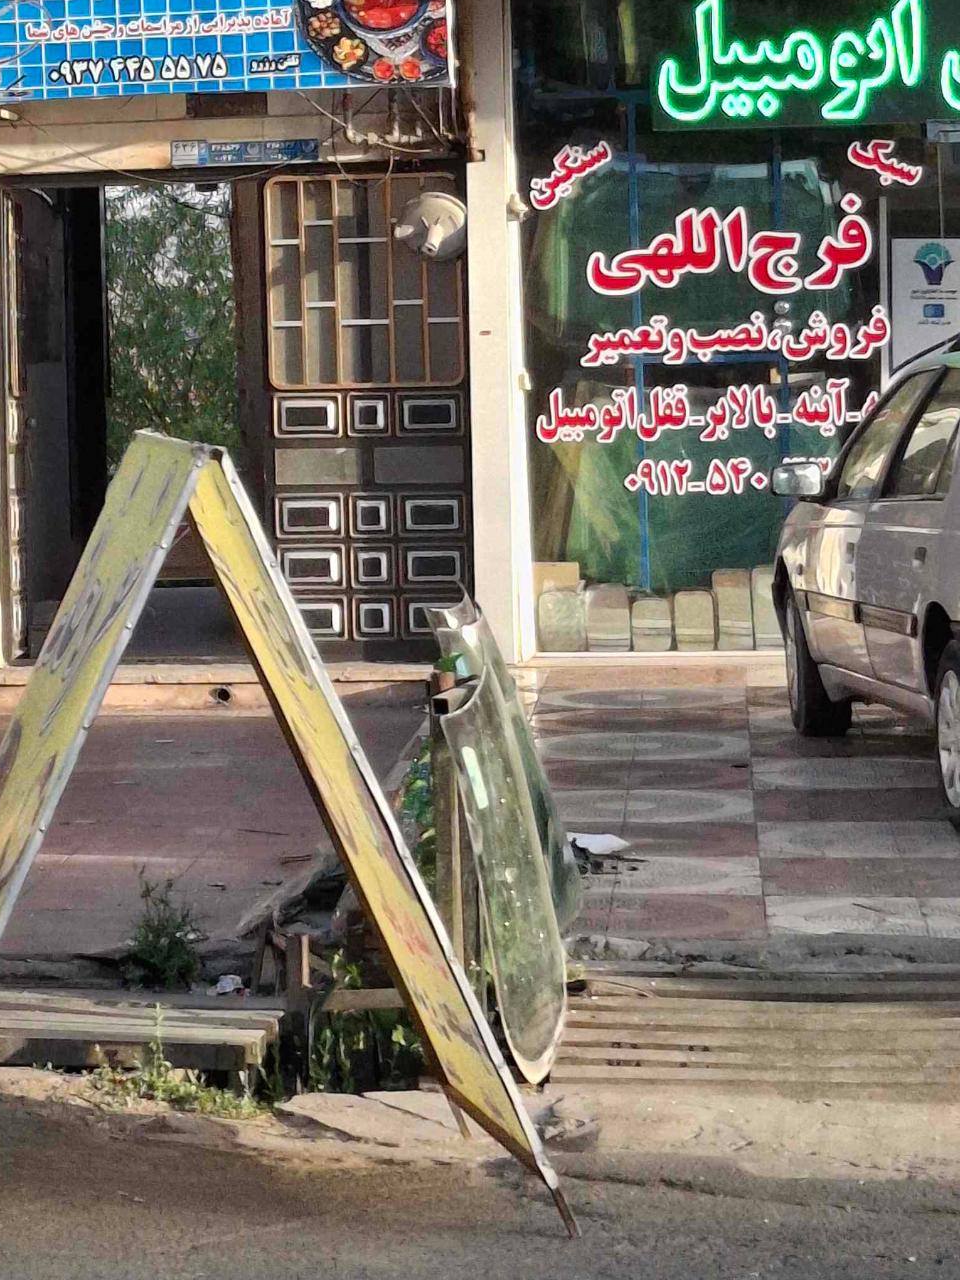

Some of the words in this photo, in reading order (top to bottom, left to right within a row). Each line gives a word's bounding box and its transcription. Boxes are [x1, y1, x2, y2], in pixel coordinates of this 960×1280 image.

[253, 8, 292, 28] آماده
[160, 54, 192, 80] ۵۵
[195, 52, 228, 79] ۷۵
[529, 140, 612, 209] سنگین
[847, 139, 923, 187] سبک
[580, 314, 665, 368] تعمیر
[662, 328, 686, 365] و
[686, 311, 768, 363] نصب
[536, 385, 638, 443] اتومبیل
